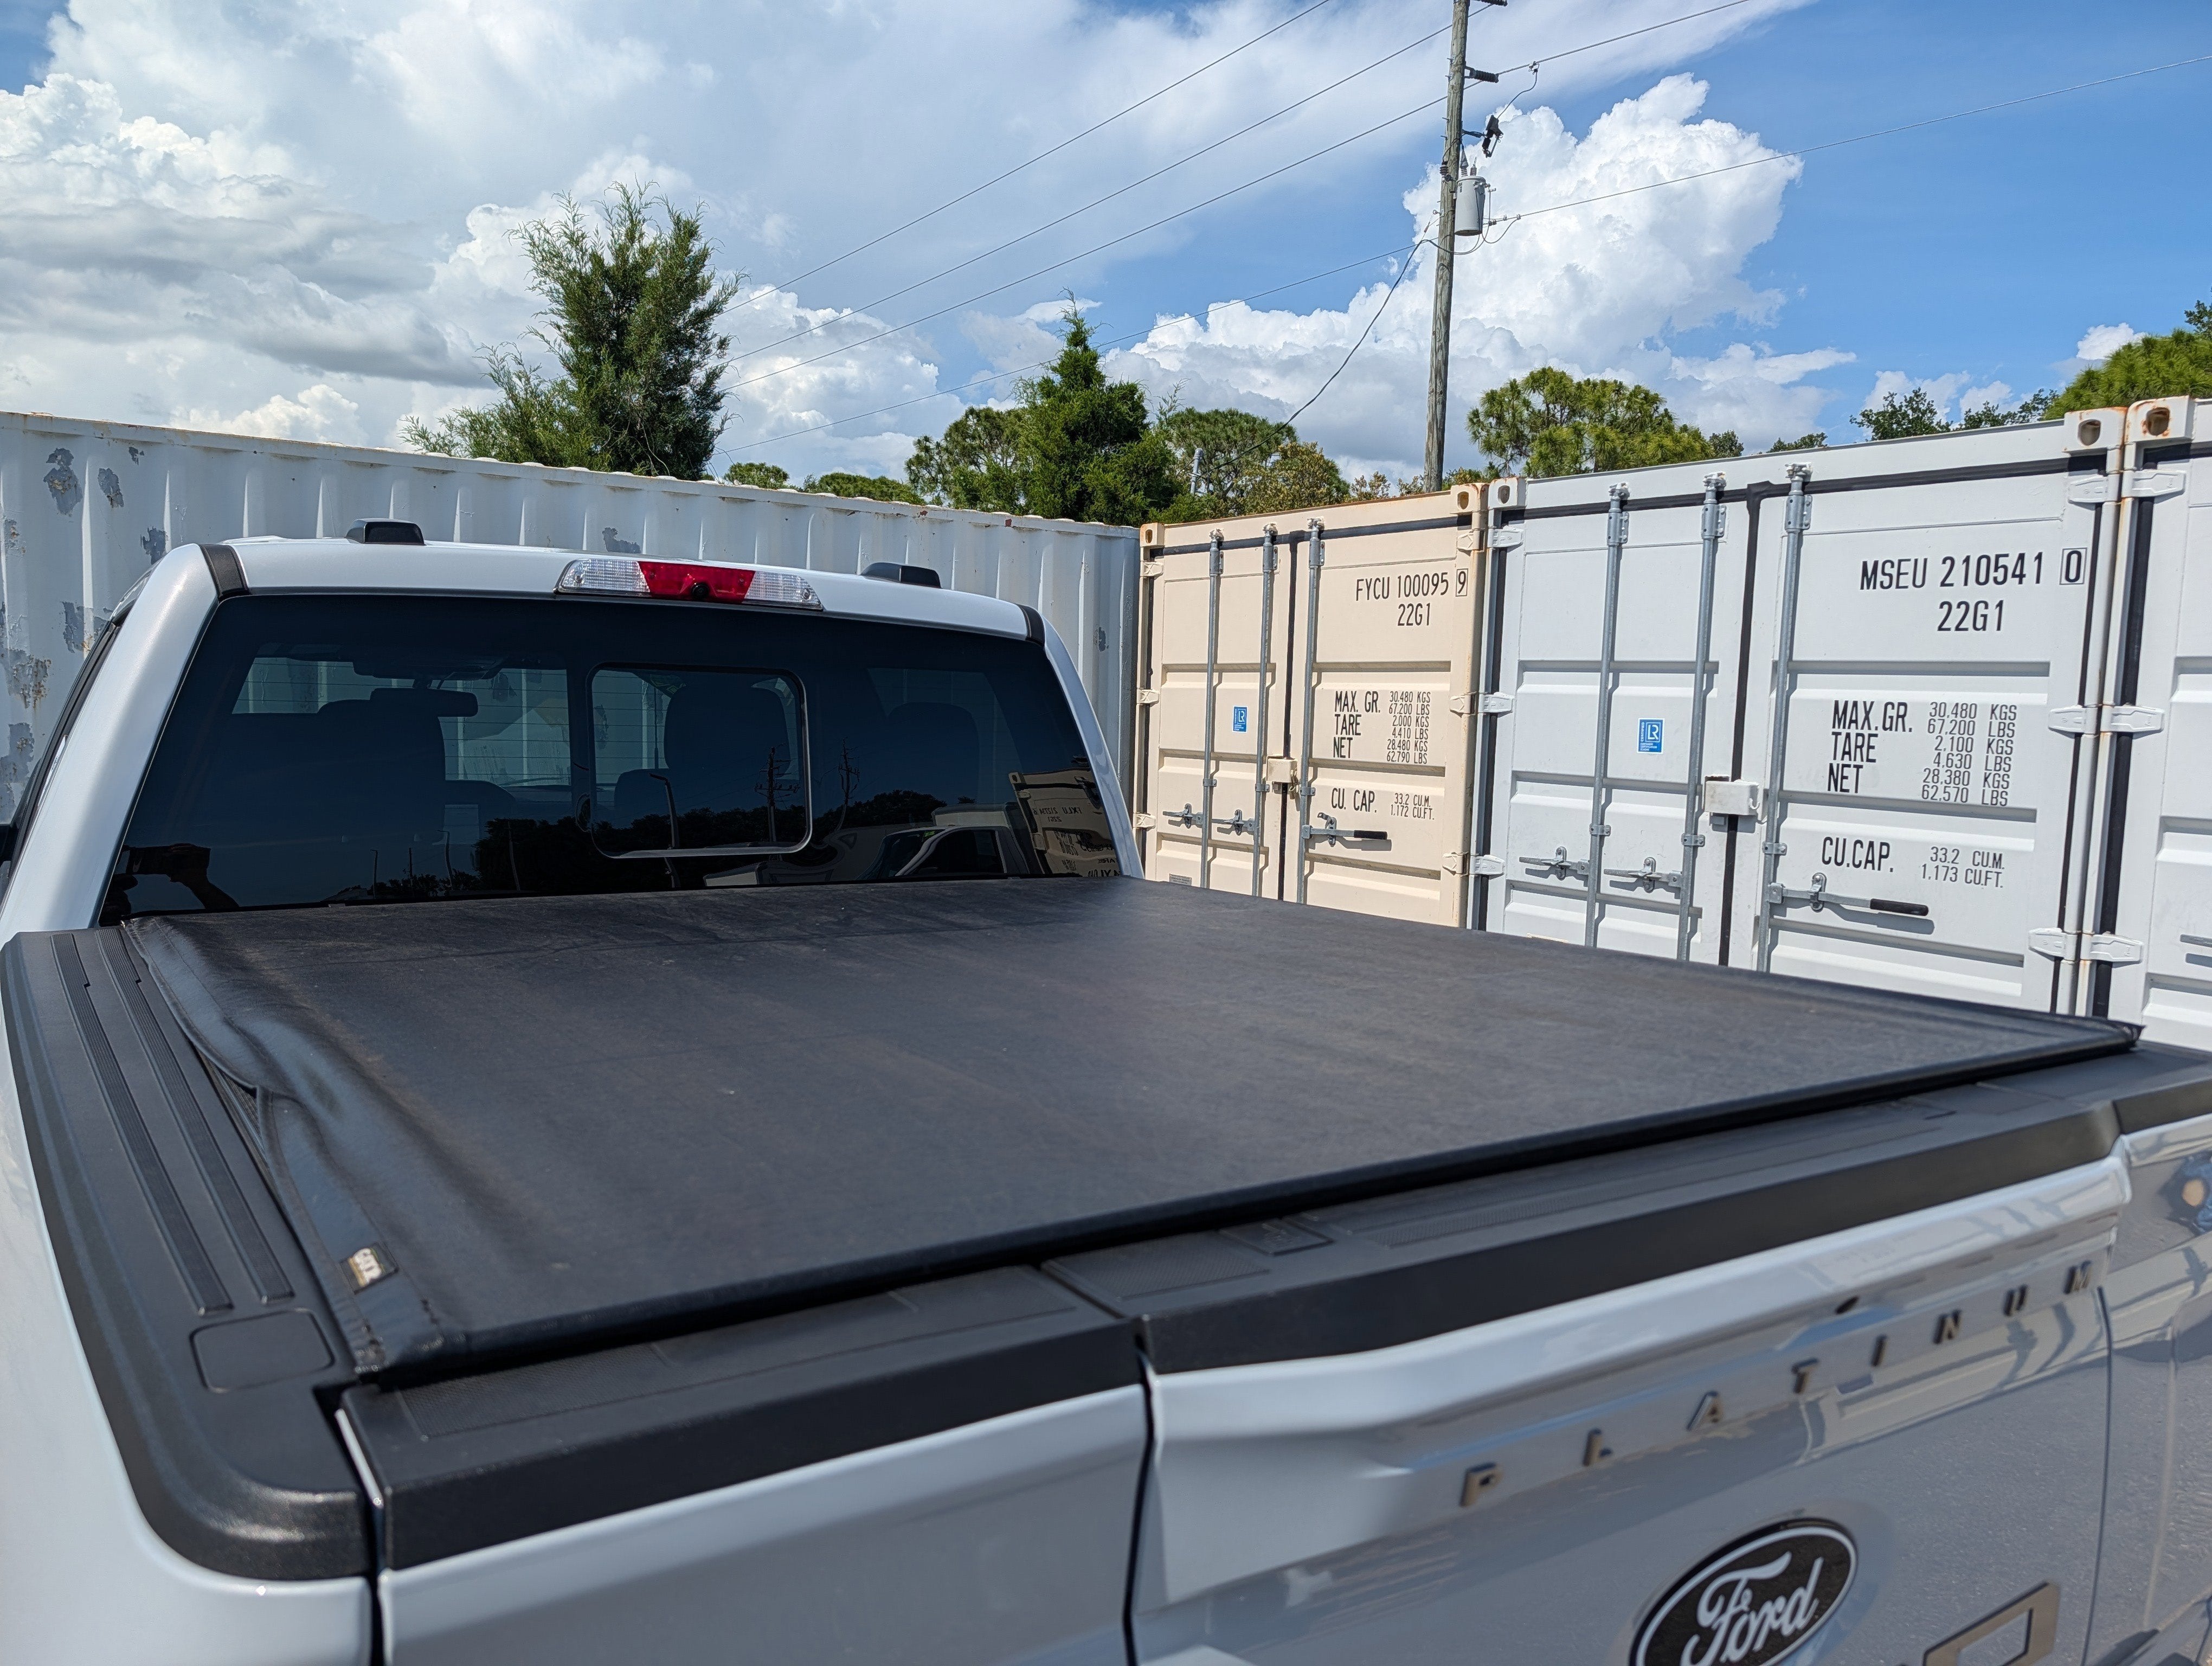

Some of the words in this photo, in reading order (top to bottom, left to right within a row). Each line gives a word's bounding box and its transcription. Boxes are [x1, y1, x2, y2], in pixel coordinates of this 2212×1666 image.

[1860, 558, 1928, 590] MSEU
[1939, 551, 2043, 587] 210541
[1356, 576, 1390, 601] FYCU
[1398, 572, 1449, 598] 100095
[1458, 571, 1466, 594] 9
[1398, 603, 1430, 626] 22G1
[1937, 600, 2004, 632] 22G1
[1335, 691, 1358, 712] MAX.
[1365, 691, 1380, 713] GR.
[1417, 691, 1431, 703] KGS
[1416, 704, 1430, 715] LBS
[1989, 703, 2017, 721] KGS
[1334, 714, 1362, 736] TARE
[1415, 716, 1429, 728] KGS
[1414, 728, 1429, 740] LBS
[1988, 721, 2015, 738] LBS
[1333, 737, 1353, 759] NET
[1414, 740, 1428, 752] KGS
[1414, 752, 1427, 764] LBS
[1831, 731, 1879, 763] TARE
[1986, 738, 2014, 755] KGS
[1984, 755, 2012, 772] LBS
[1827, 762, 1863, 794] NET
[1983, 772, 2010, 790] KGS
[1331, 787, 1346, 810] CU.
[1353, 790, 1377, 813] CAP.
[1394, 792, 1410, 805] 33.2
[1413, 794, 1431, 808] CU.M.
[1981, 789, 2009, 806] LBS
[1412, 806, 1435, 820] CU.FT.
[1930, 846, 1960, 864] 33.2
[1972, 850, 2005, 869] CU.M.
[1964, 868, 2004, 888] CU.FT.
[1460, 1261, 2093, 1508] PLATINUM
[1681, 1550, 1824, 1666] Ford
